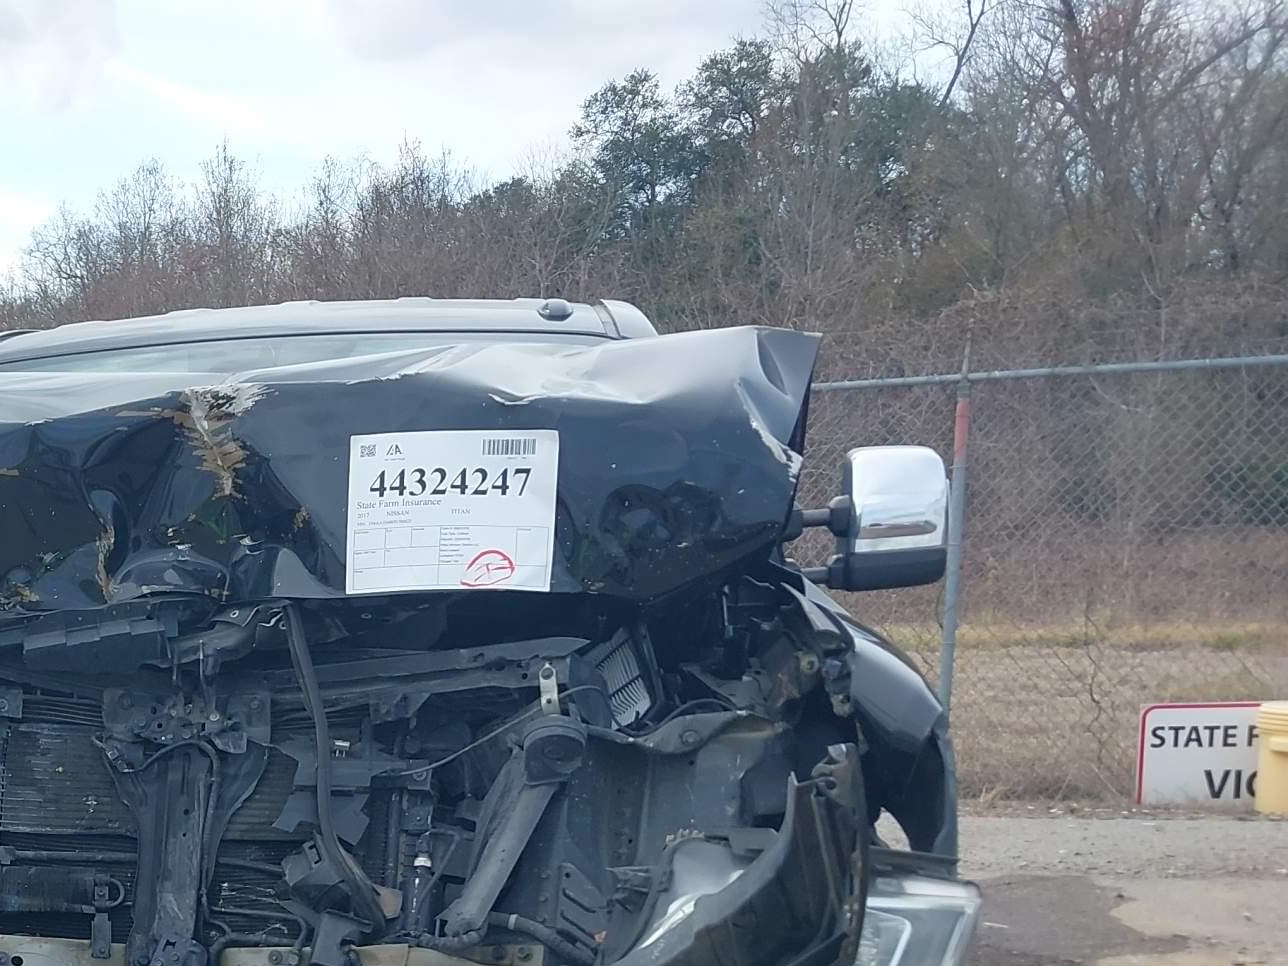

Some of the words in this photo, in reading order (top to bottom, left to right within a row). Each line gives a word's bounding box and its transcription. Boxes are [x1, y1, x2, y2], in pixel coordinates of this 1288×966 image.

[369, 467, 532, 498] 44324247
[356, 501, 377, 510] State
[379, 499, 399, 509] Farm
[402, 498, 442, 508] Insurance
[1150, 725, 1239, 748] STATE
